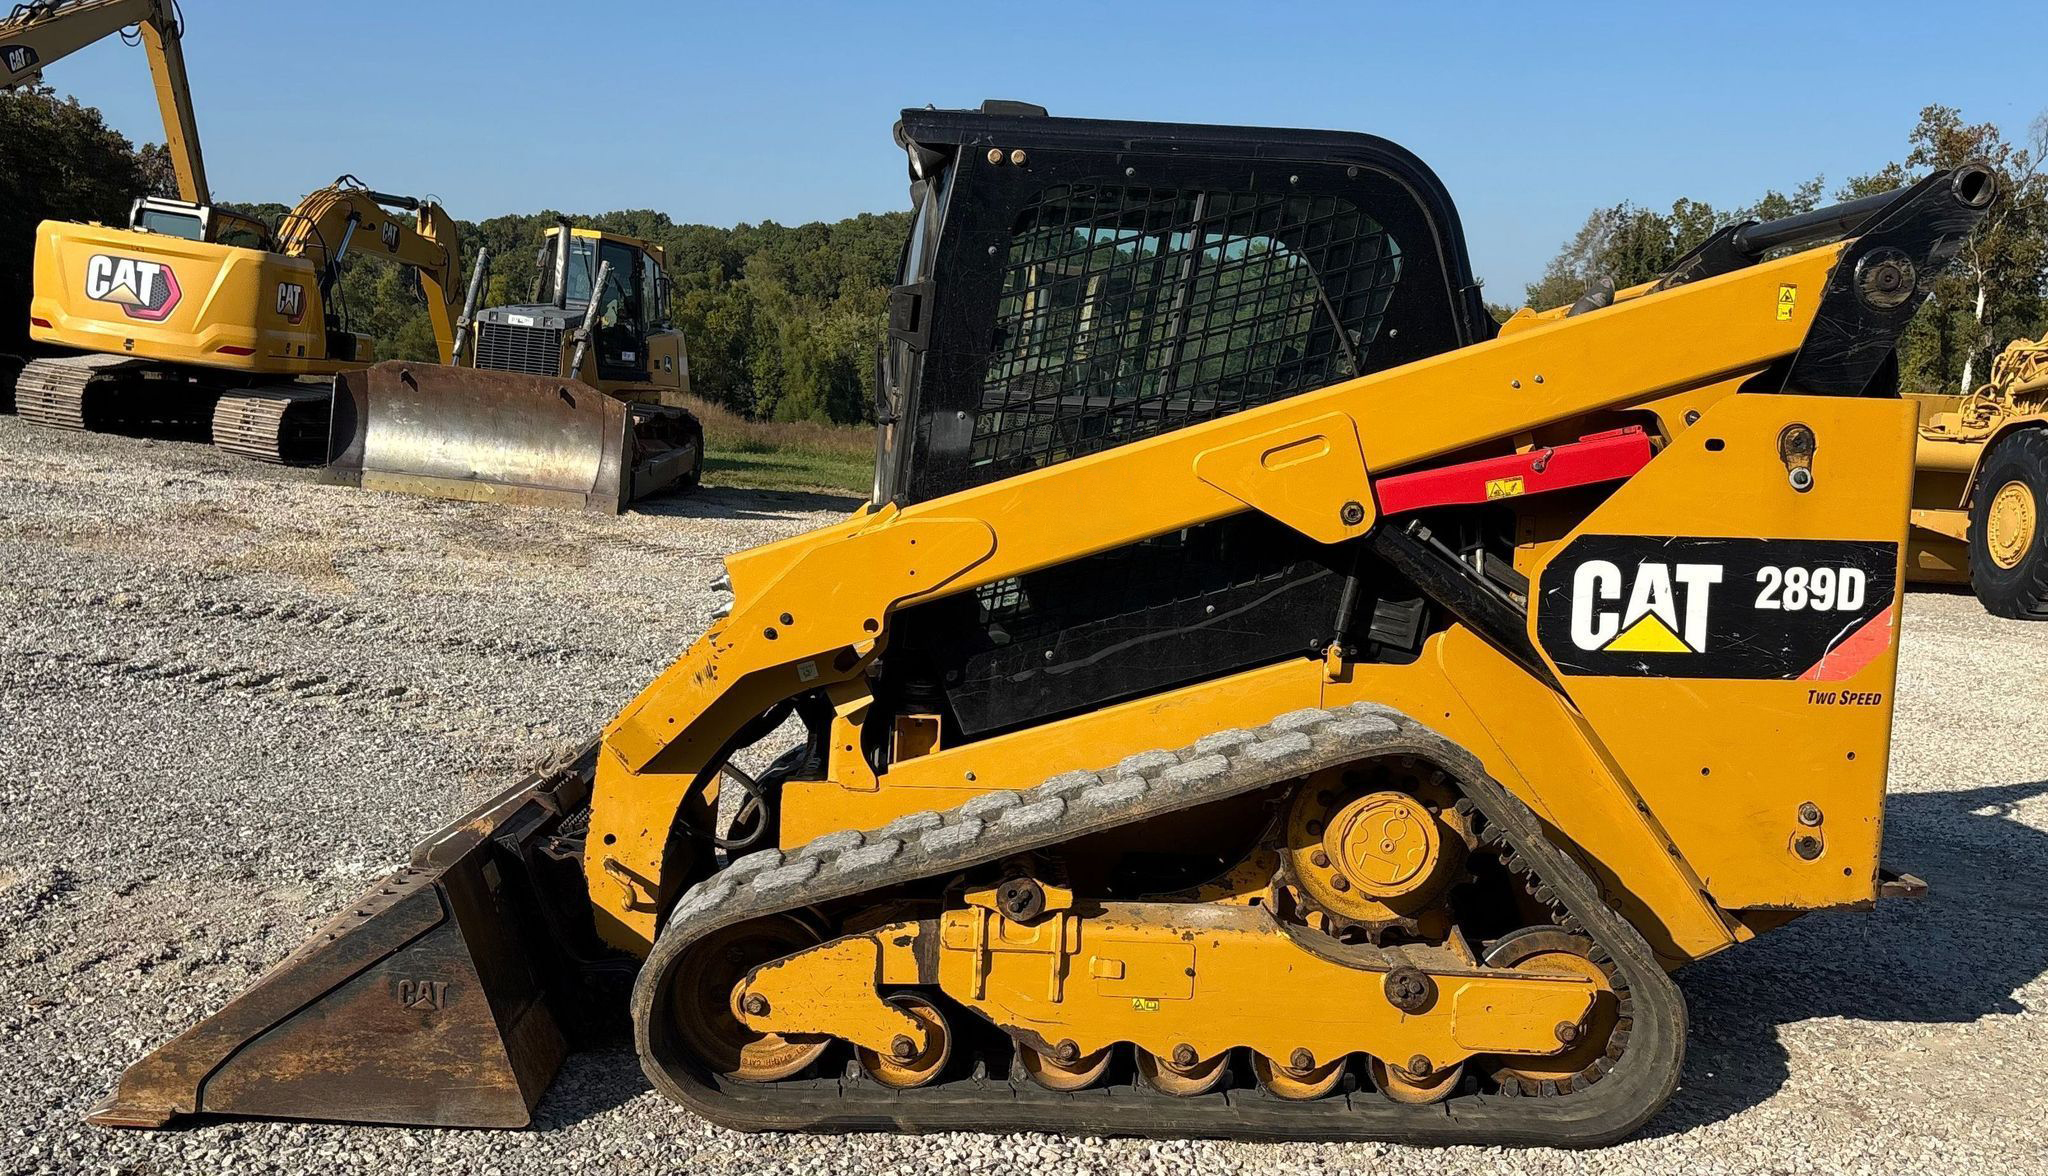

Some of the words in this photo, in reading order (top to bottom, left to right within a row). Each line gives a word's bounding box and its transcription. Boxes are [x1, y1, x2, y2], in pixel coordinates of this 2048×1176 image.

[9, 48, 26, 72] CAT
[383, 221, 398, 246] CAT
[87, 255, 160, 307] CAT
[277, 283, 301, 315] CAT
[1571, 560, 1723, 653] CAT
[1755, 566, 1866, 611] 289D
[398, 980, 449, 1011] CAT
